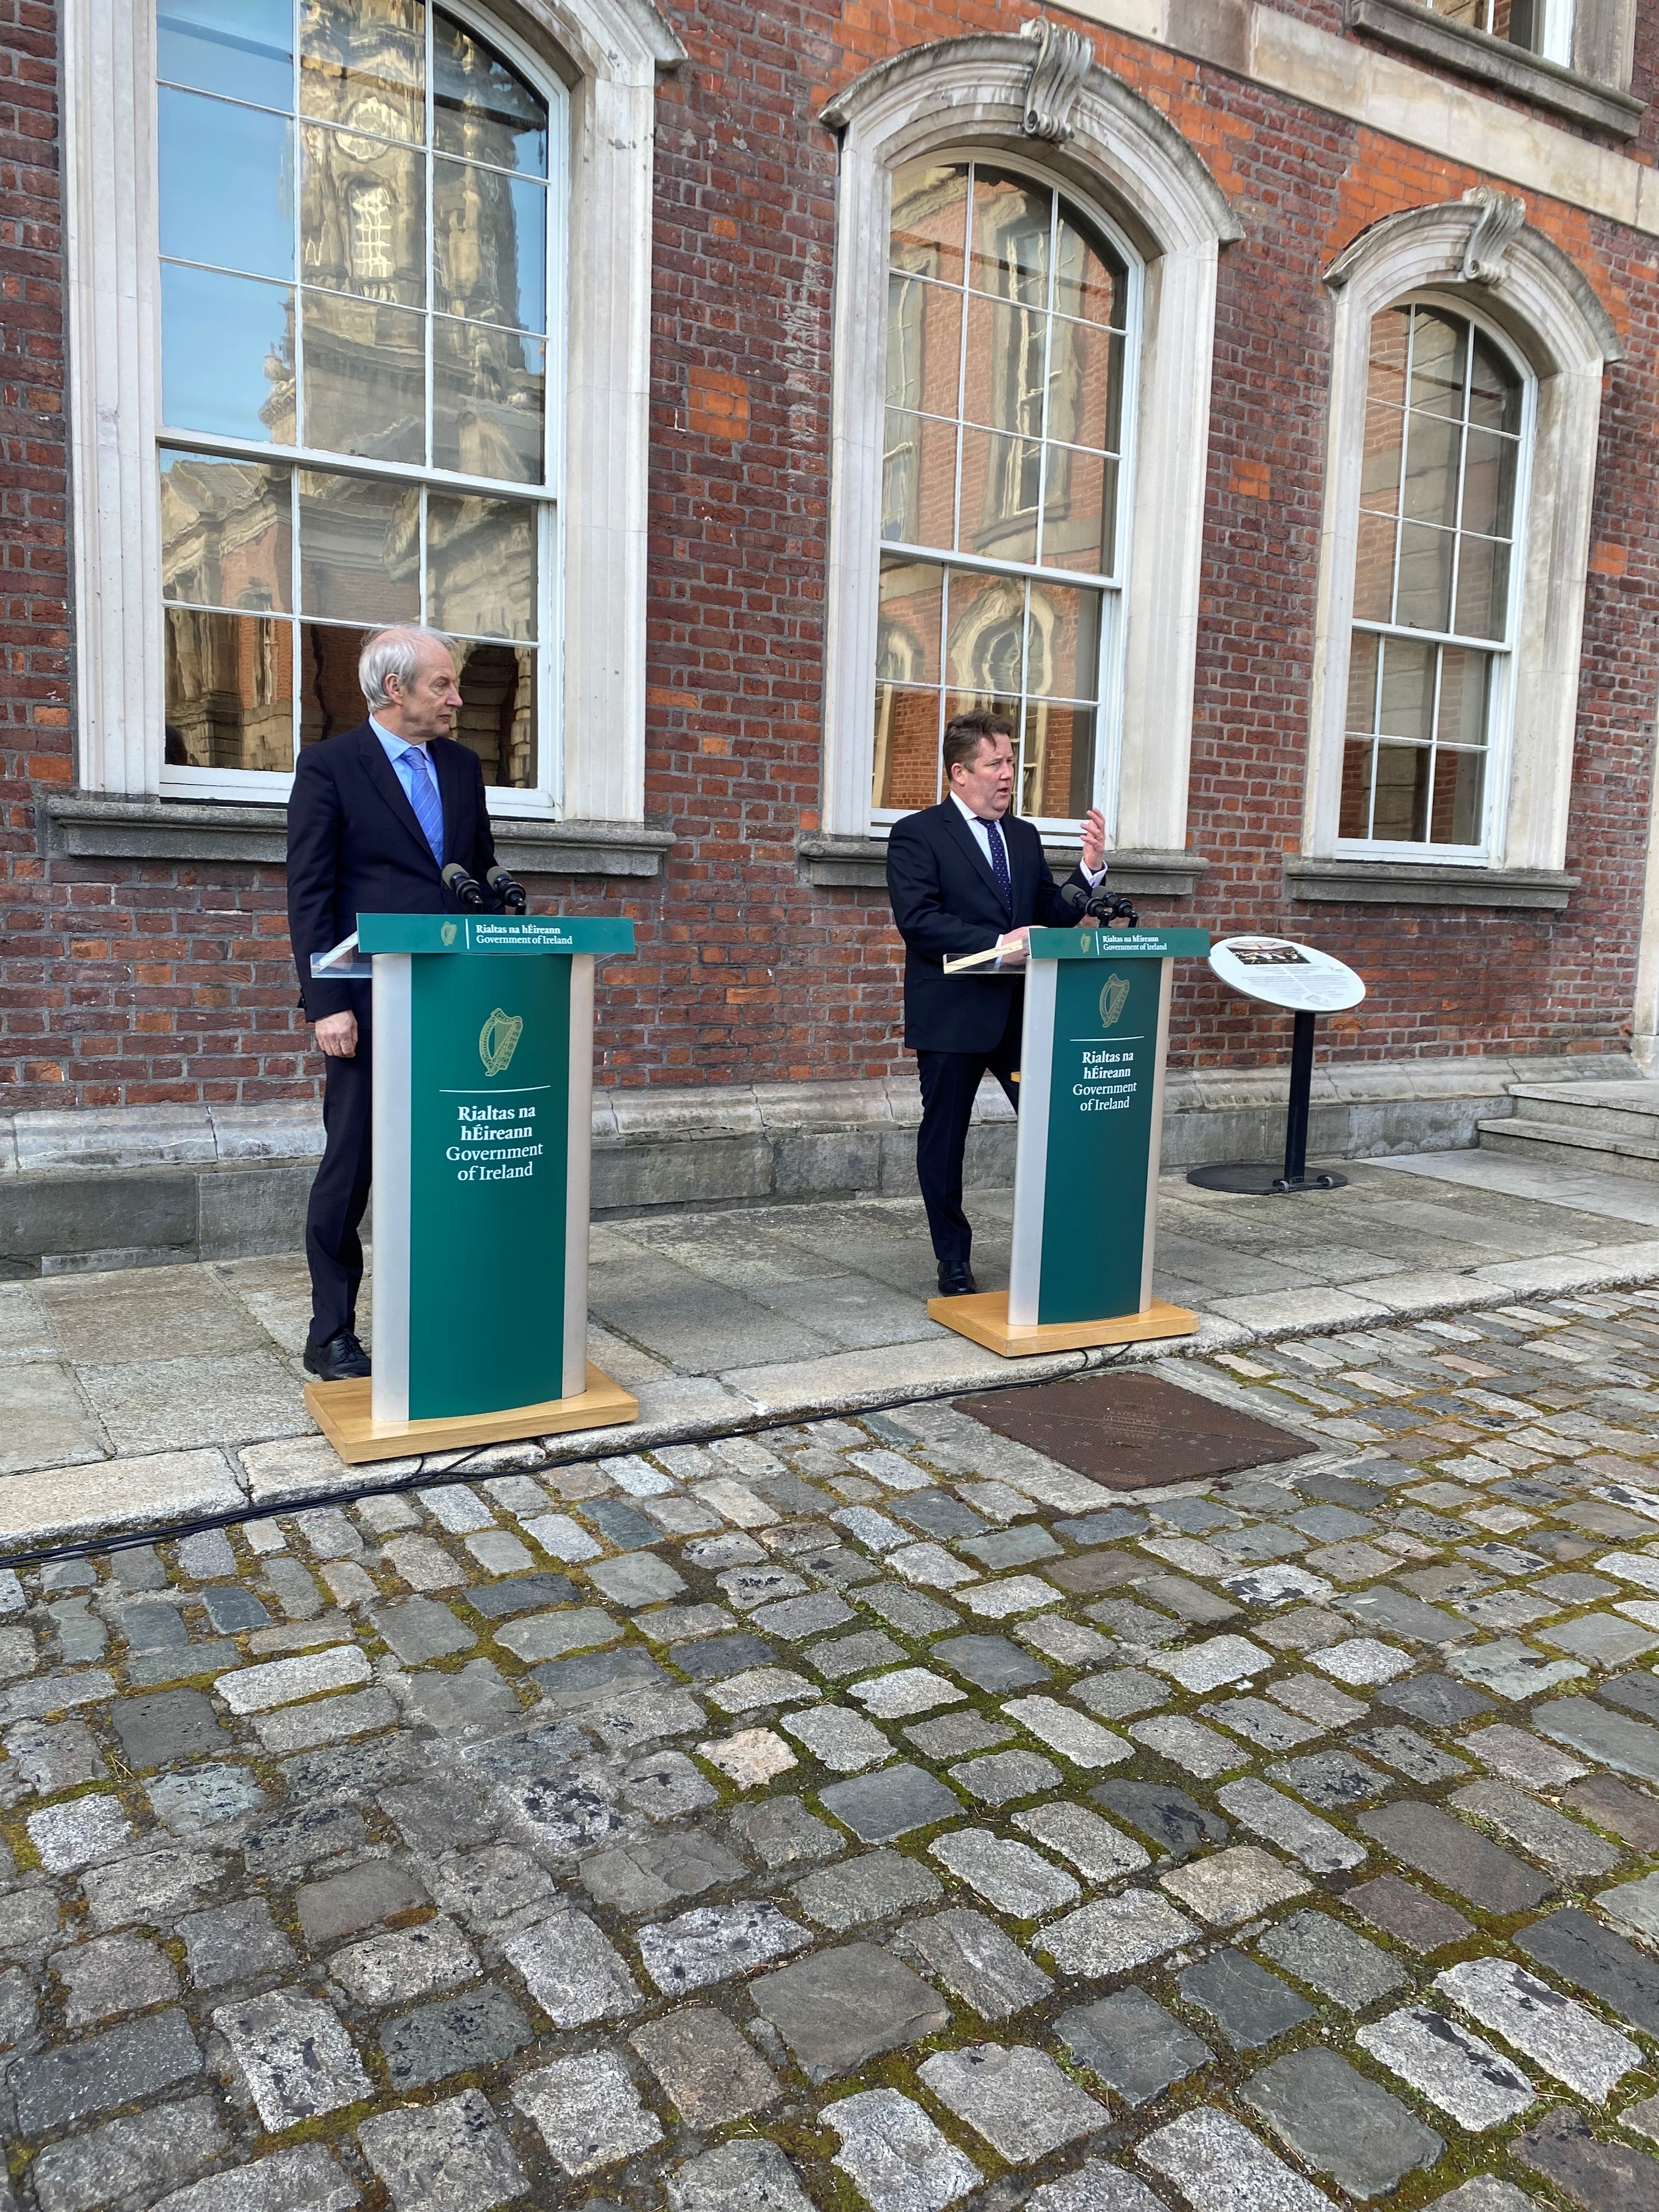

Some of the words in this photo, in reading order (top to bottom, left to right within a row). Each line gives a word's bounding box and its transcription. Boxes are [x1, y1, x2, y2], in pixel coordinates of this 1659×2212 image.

[475, 924, 507, 934] Rialtas
[521, 923, 561, 934] hÉireann
[476, 934, 532, 944] Government
[532, 935, 543, 944] of
[543, 935, 573, 944] Ireland
[1102, 935, 1124, 943] Rialtas
[1132, 934, 1159, 943] hÉireann
[1103, 943, 1139, 951] Government
[1139, 943, 1147, 951] of
[1081, 1050, 1121, 1064] Rialtas
[1122, 1052, 1134, 1062] na
[1083, 1065, 1131, 1079] hÉireann
[1073, 1082, 1137, 1096] Government
[1080, 1098, 1095, 1111] of
[1094, 1097, 1130, 1111] Ireland
[457, 1105, 515, 1122] Rialtas
[518, 1107, 536, 1119] na
[460, 1124, 533, 1141] hÉireann
[445, 1143, 544, 1161] Government
[458, 1165, 479, 1181] of
[478, 1161, 533, 1181] Ireland
